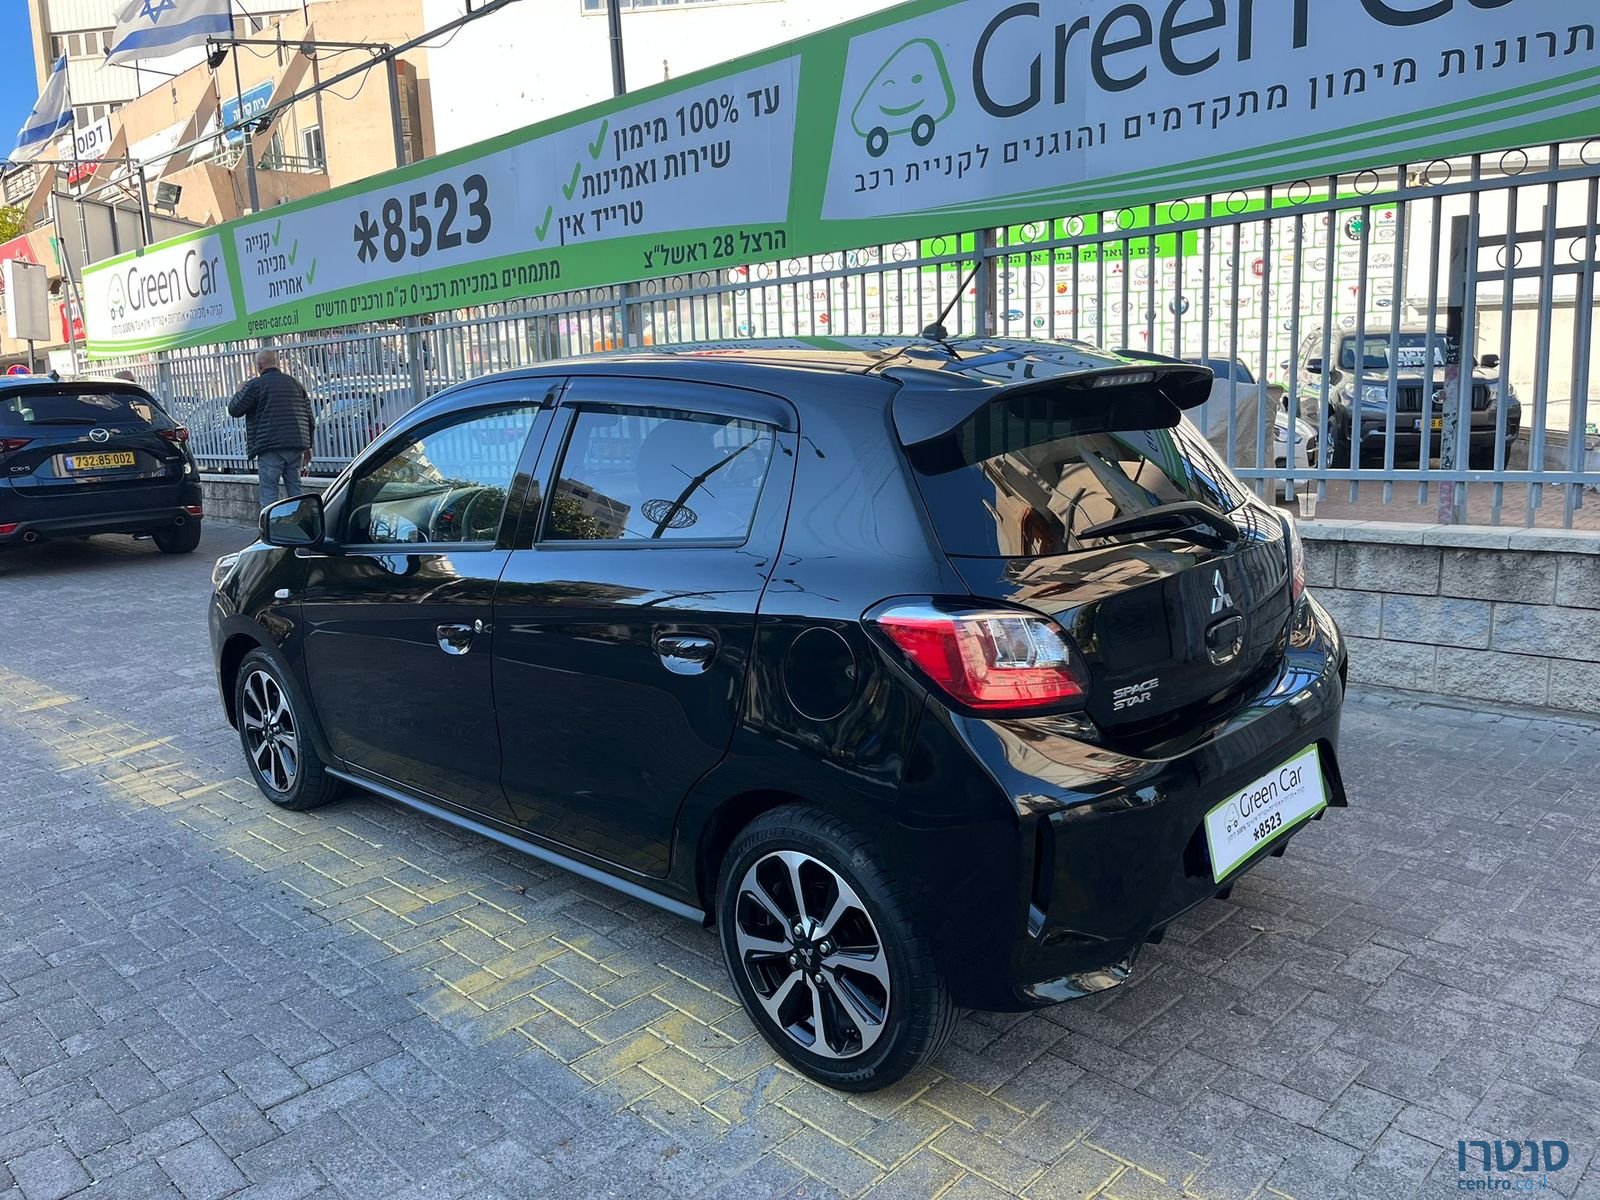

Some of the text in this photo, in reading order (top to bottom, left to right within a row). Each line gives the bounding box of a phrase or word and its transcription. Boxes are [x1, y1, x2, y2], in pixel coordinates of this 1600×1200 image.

[1308, 58, 1417, 110] מימון
[613, 85, 780, 161] עד 100% מימון
[1124, 84, 1288, 139] מתקדמים
[77, 125, 103, 154] דפוס
[1003, 122, 1106, 164] והוגנים
[582, 140, 731, 199] שירות ואמינות
[905, 143, 989, 183] לקניית
[854, 168, 894, 193] רכב
[558, 200, 644, 246] טרייד אין
[245, 232, 270, 254] קנייה
[713, 234, 734, 259] 28
[740, 229, 786, 254] הרצל
[257, 254, 286, 275] מכירה
[502, 259, 560, 288] מתמחים
[127, 249, 218, 311] Green Car
[269, 276, 303, 298] אחריות
[420, 282, 453, 301] רכבי
[450, 272, 498, 297] במכירת
[350, 293, 383, 313] ורכבים
[410, 287, 418, 304] 0
[315, 299, 347, 319] חדשים
[247, 310, 299, 335] green-car.co.il
[1113, 678, 1159, 700] SPACE
[1113, 692, 1151, 711] STAR
[1239, 781, 1278, 818] Green
[1279, 766, 1302, 792] Car
